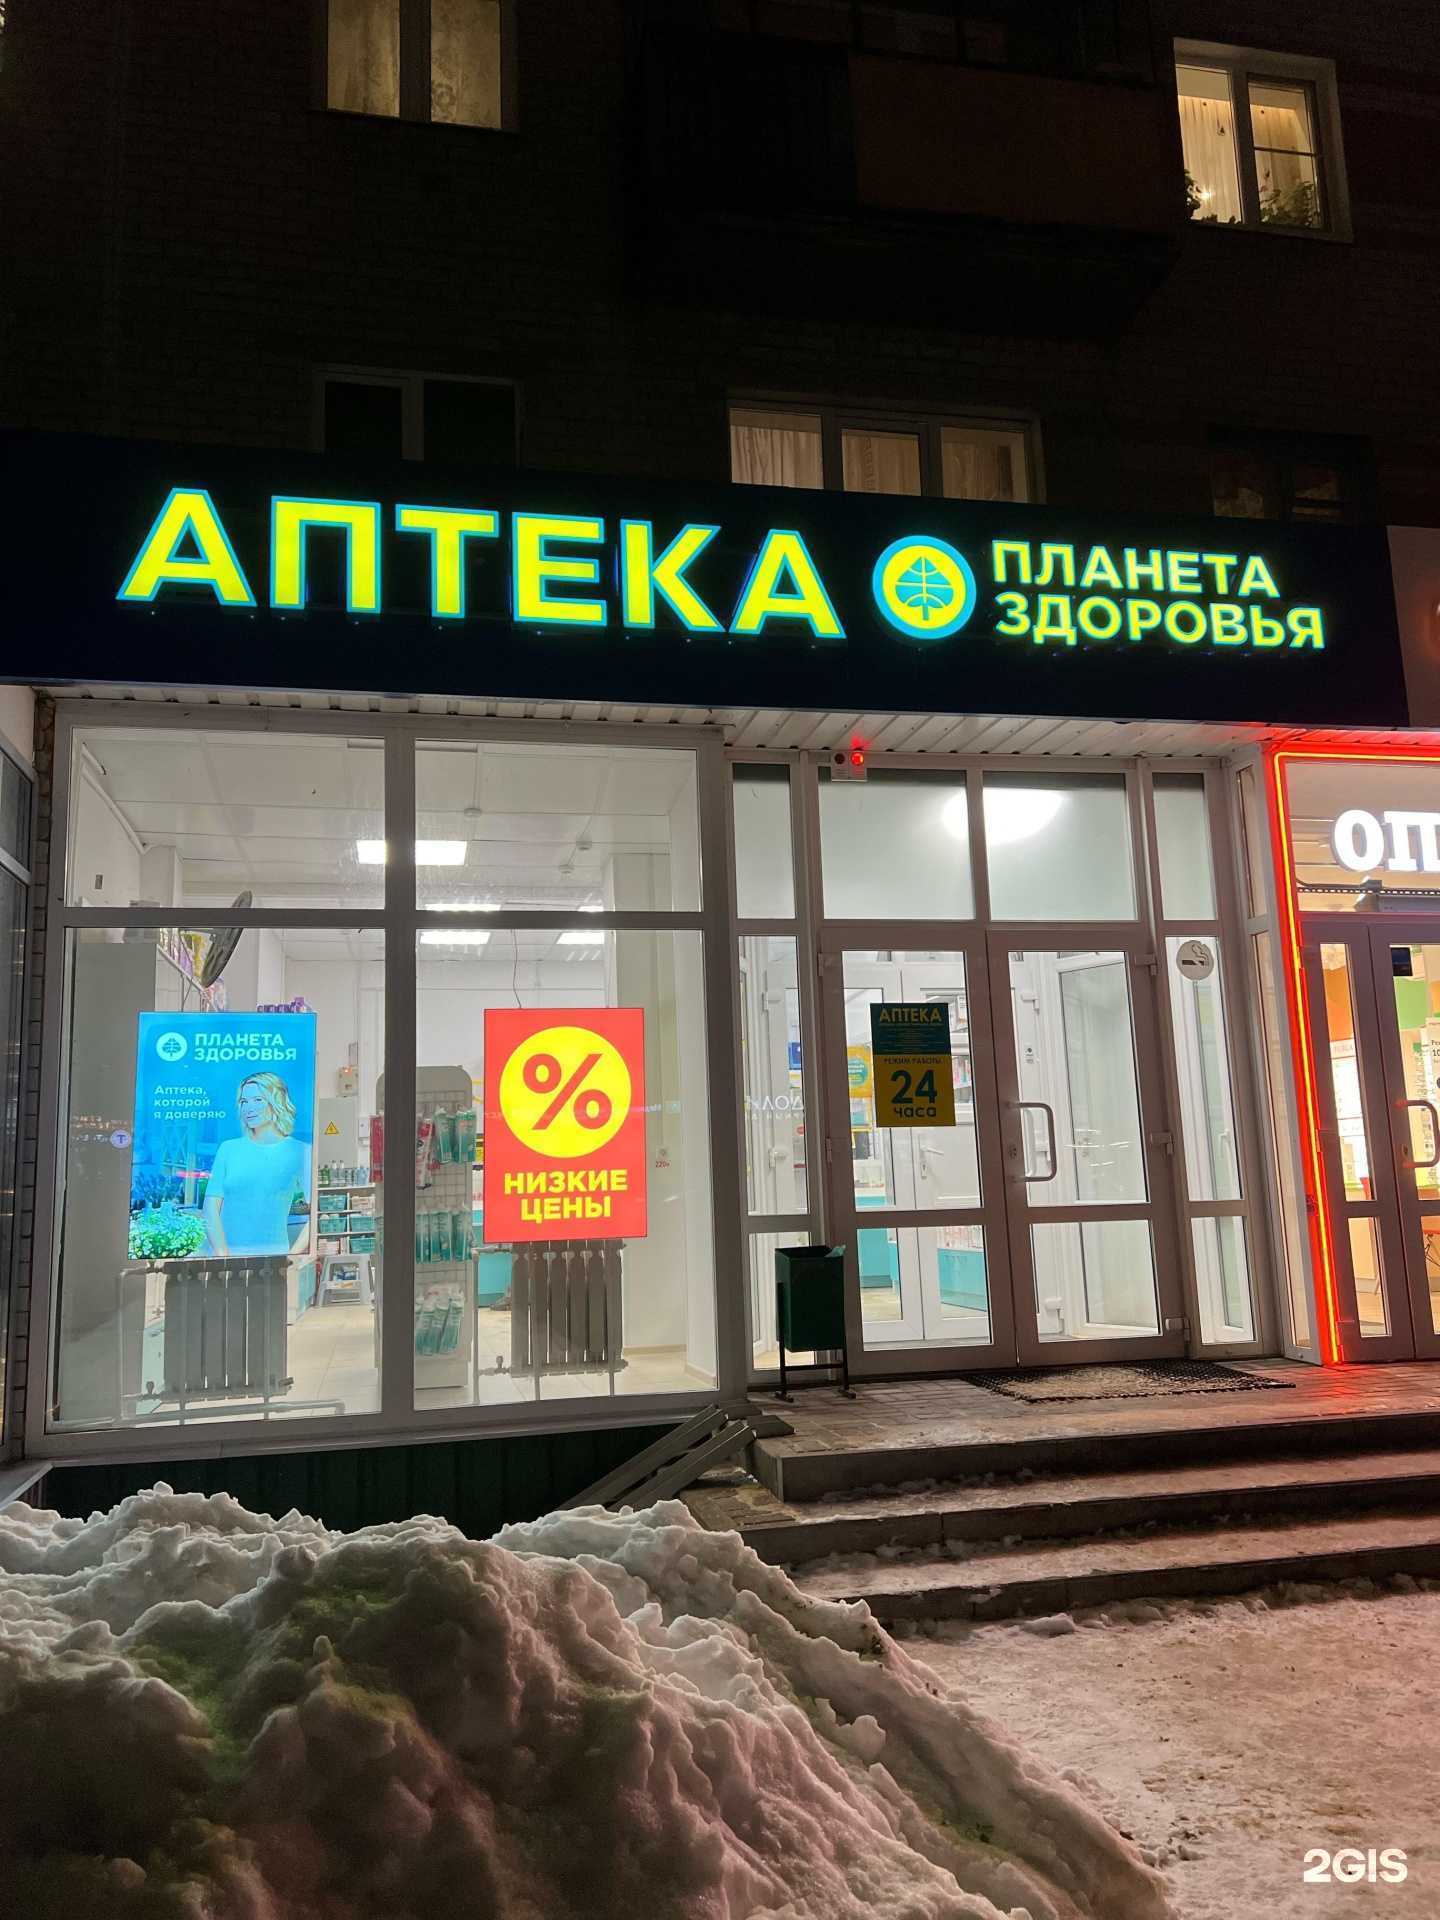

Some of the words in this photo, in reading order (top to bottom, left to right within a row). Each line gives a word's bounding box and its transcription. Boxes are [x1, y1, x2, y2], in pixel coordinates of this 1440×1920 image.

[115, 487, 847, 639] АПТЕКА
[991, 539, 1281, 598] ПЛАНЕТА
[994, 591, 1325, 649] ЗДОРОВЬЯ
[879, 1007, 942, 1023] АПТЕКА
[194, 1033, 285, 1046] ПЛАНЕТА
[194, 1048, 297, 1063] ЗДОРОВЬЯ
[154, 1085, 207, 1096] Аптека,
[522, 1052, 613, 1131] %
[890, 1069, 938, 1105] 24
[154, 1096, 211, 1109] которой
[894, 1107, 937, 1118] часа
[154, 1110, 161, 1120] я
[165, 1109, 227, 1121] доверяю
[504, 1168, 629, 1195] НИЗКИЕ
[520, 1195, 612, 1225] ЦЕНЫ
